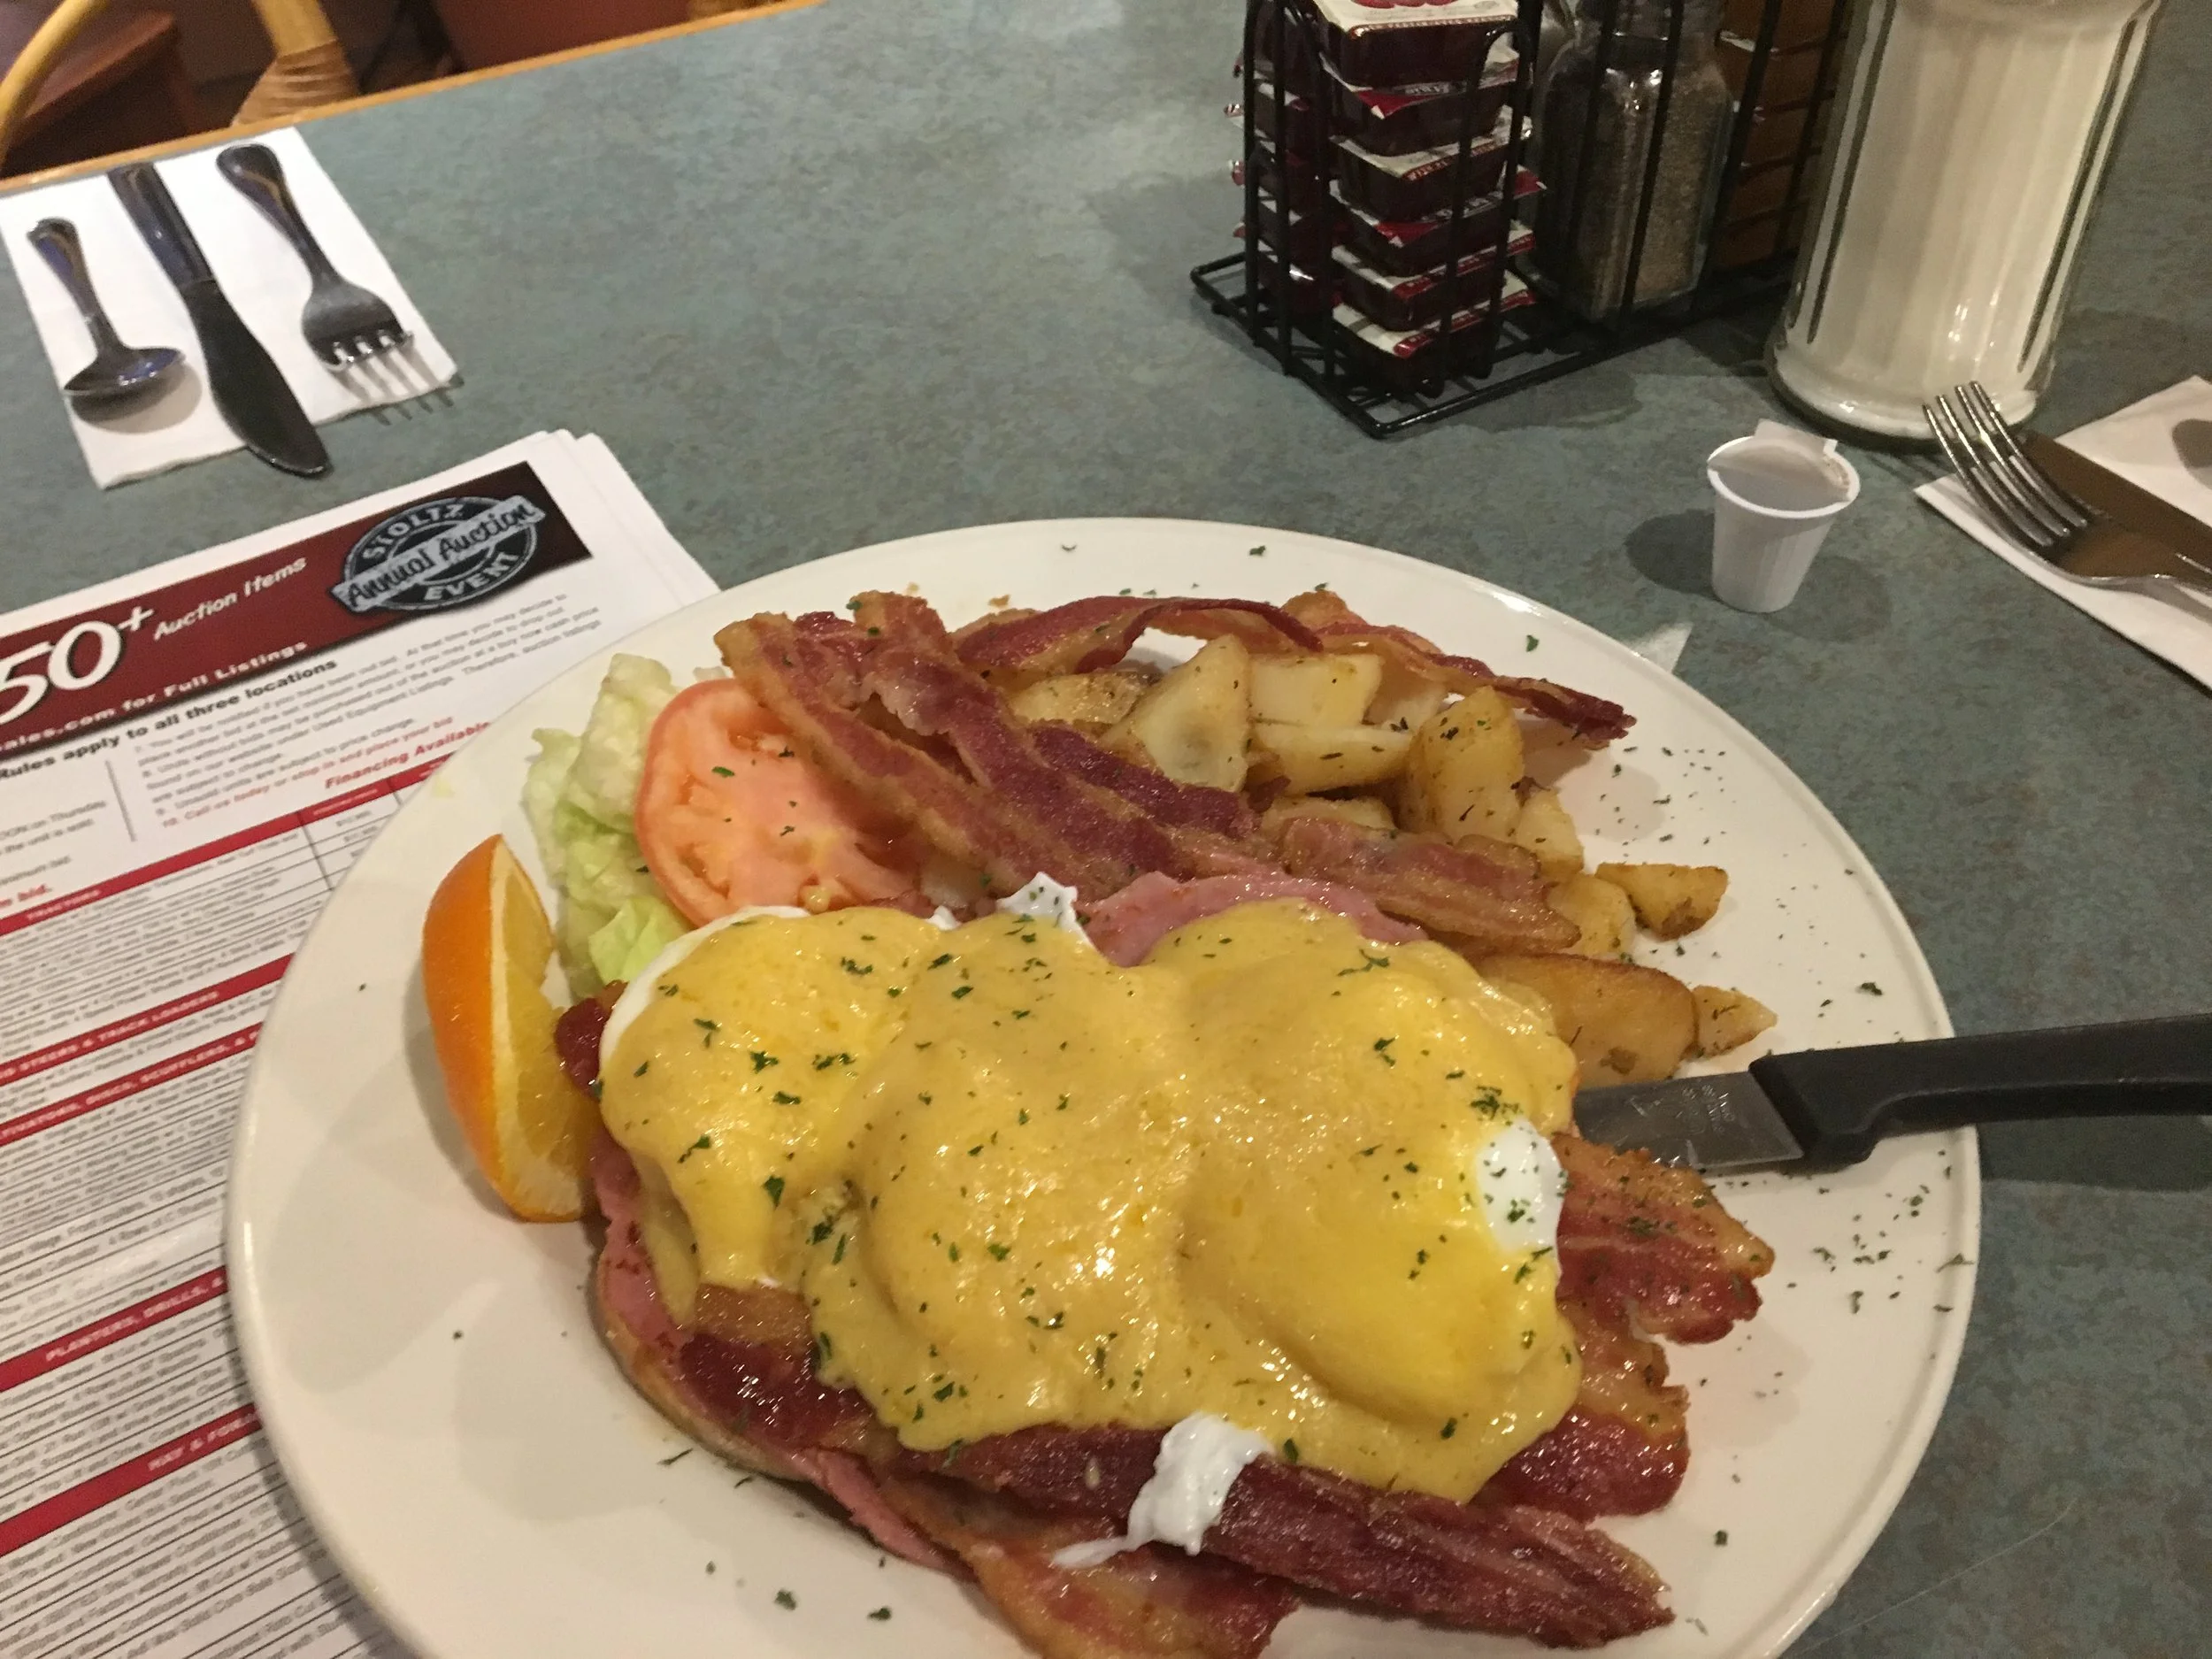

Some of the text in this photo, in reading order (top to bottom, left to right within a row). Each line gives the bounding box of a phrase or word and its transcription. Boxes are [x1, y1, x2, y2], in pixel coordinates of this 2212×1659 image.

[348, 504, 536, 607] Annual Auction
[363, 503, 465, 560] STOLTZ
[153, 557, 308, 641] Auction Items
[424, 552, 520, 601] EVENT
[63, 734, 120, 761] apply
[127, 726, 150, 739] to
[155, 714, 180, 731] all
[185, 694, 241, 718] three
[244, 660, 337, 698] locations
[122, 694, 156, 712] for
[164, 674, 210, 697] Full
[214, 641, 308, 680] Listings
[325, 752, 410, 789] Financing
